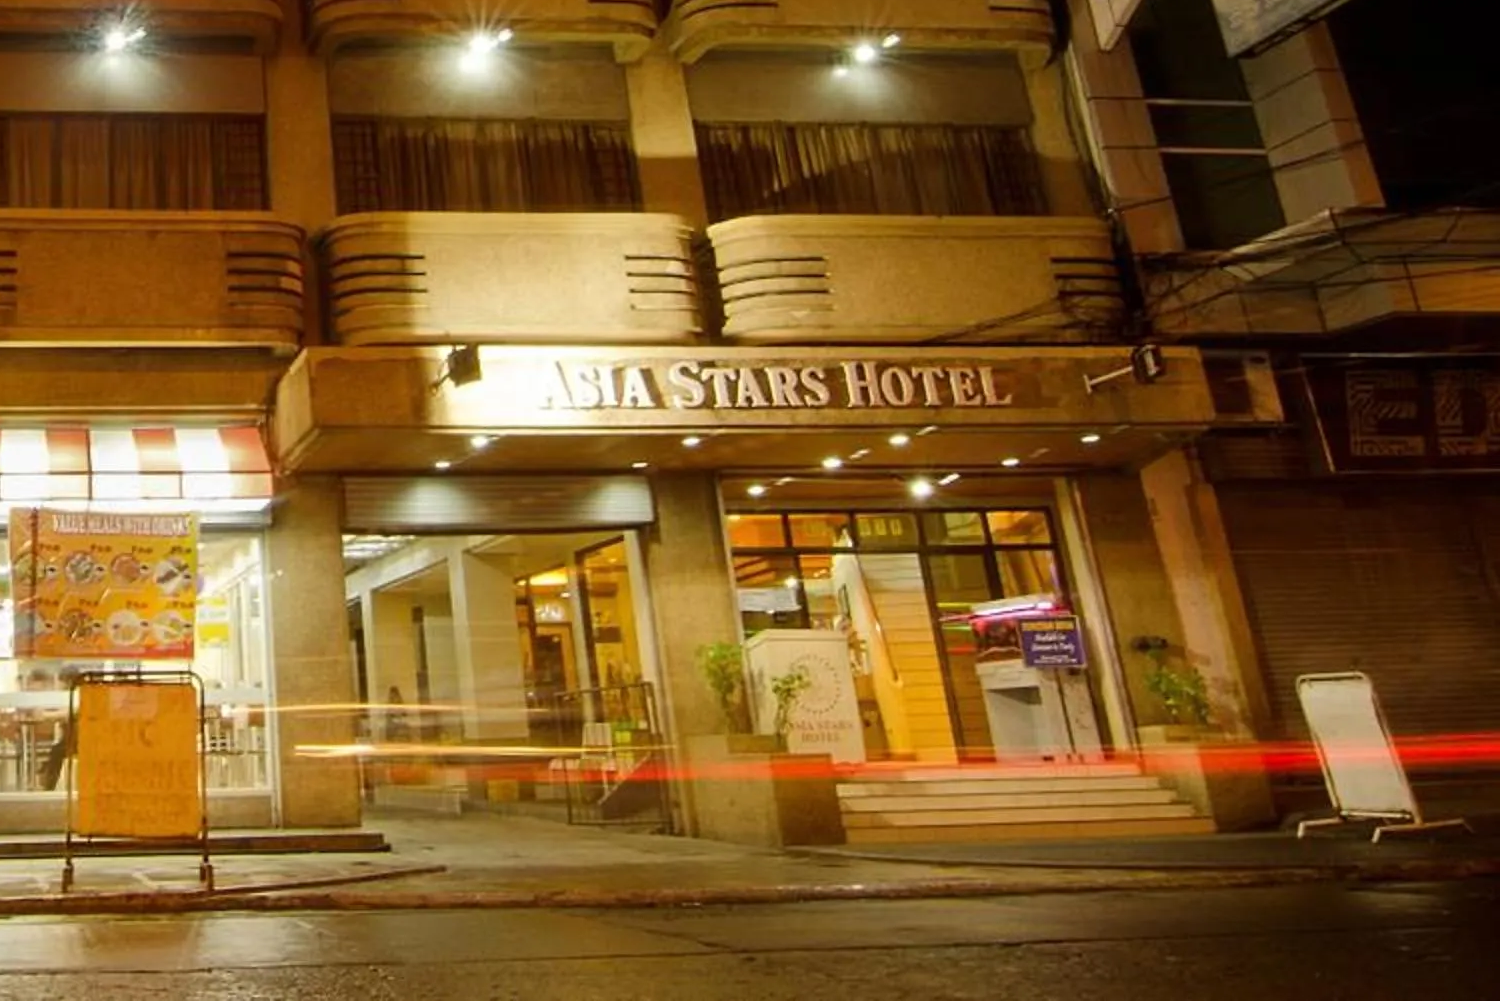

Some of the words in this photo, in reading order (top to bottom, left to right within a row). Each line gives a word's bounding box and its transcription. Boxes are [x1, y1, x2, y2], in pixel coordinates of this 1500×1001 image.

[538, 360, 658, 409] ASIA
[668, 360, 831, 409] STARS
[840, 360, 1013, 409] HOTEL
